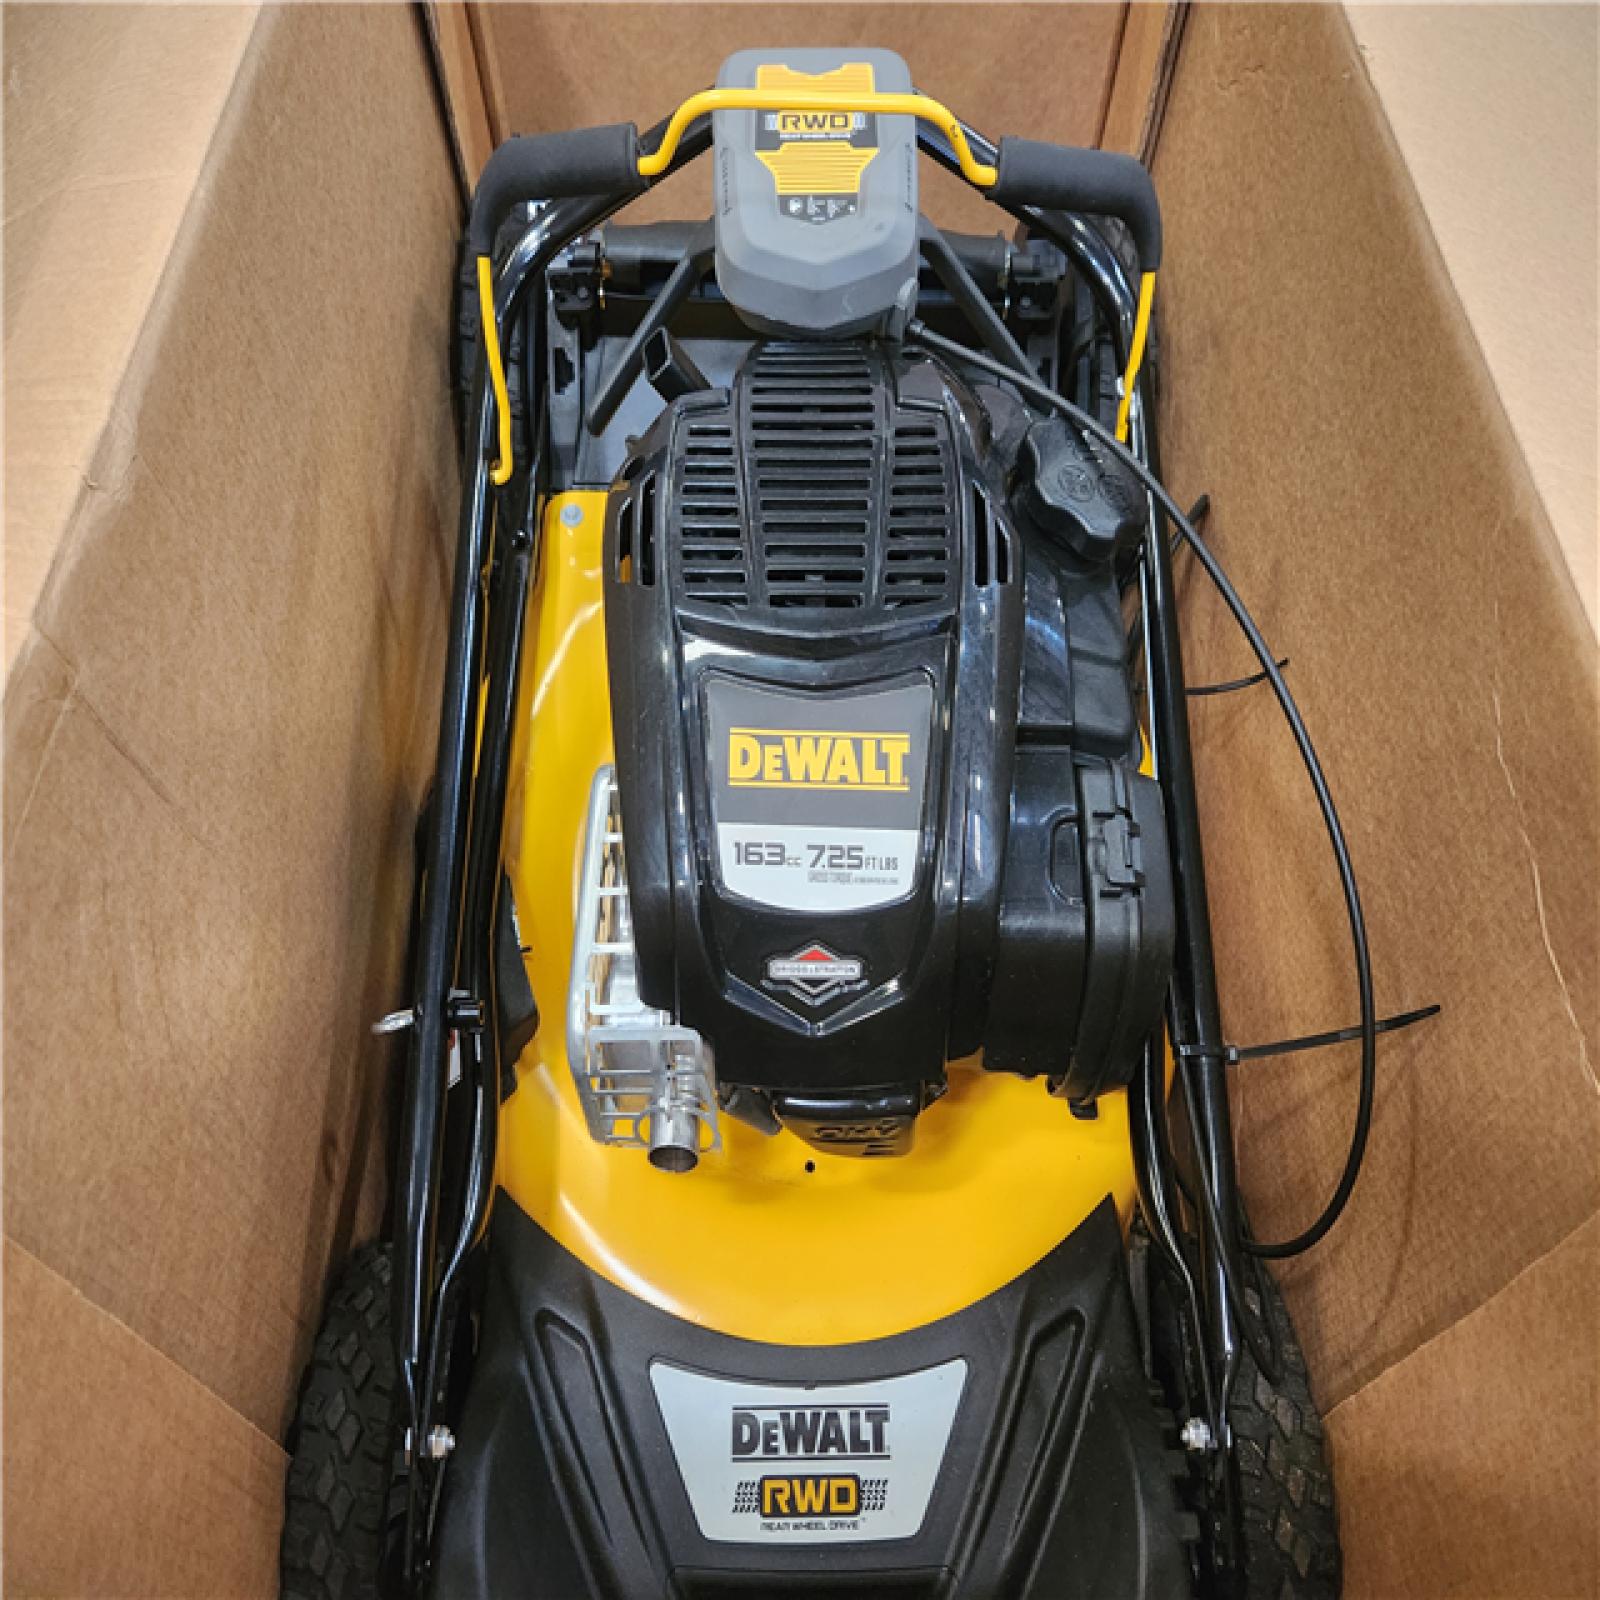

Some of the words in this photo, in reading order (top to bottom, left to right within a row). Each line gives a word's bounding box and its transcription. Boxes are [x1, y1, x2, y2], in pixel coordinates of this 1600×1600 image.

[781, 114, 849, 129] RWD
[729, 734, 911, 785] DEWALT
[732, 1411, 889, 1456] DEWALT
[763, 1478, 856, 1514] RWD
